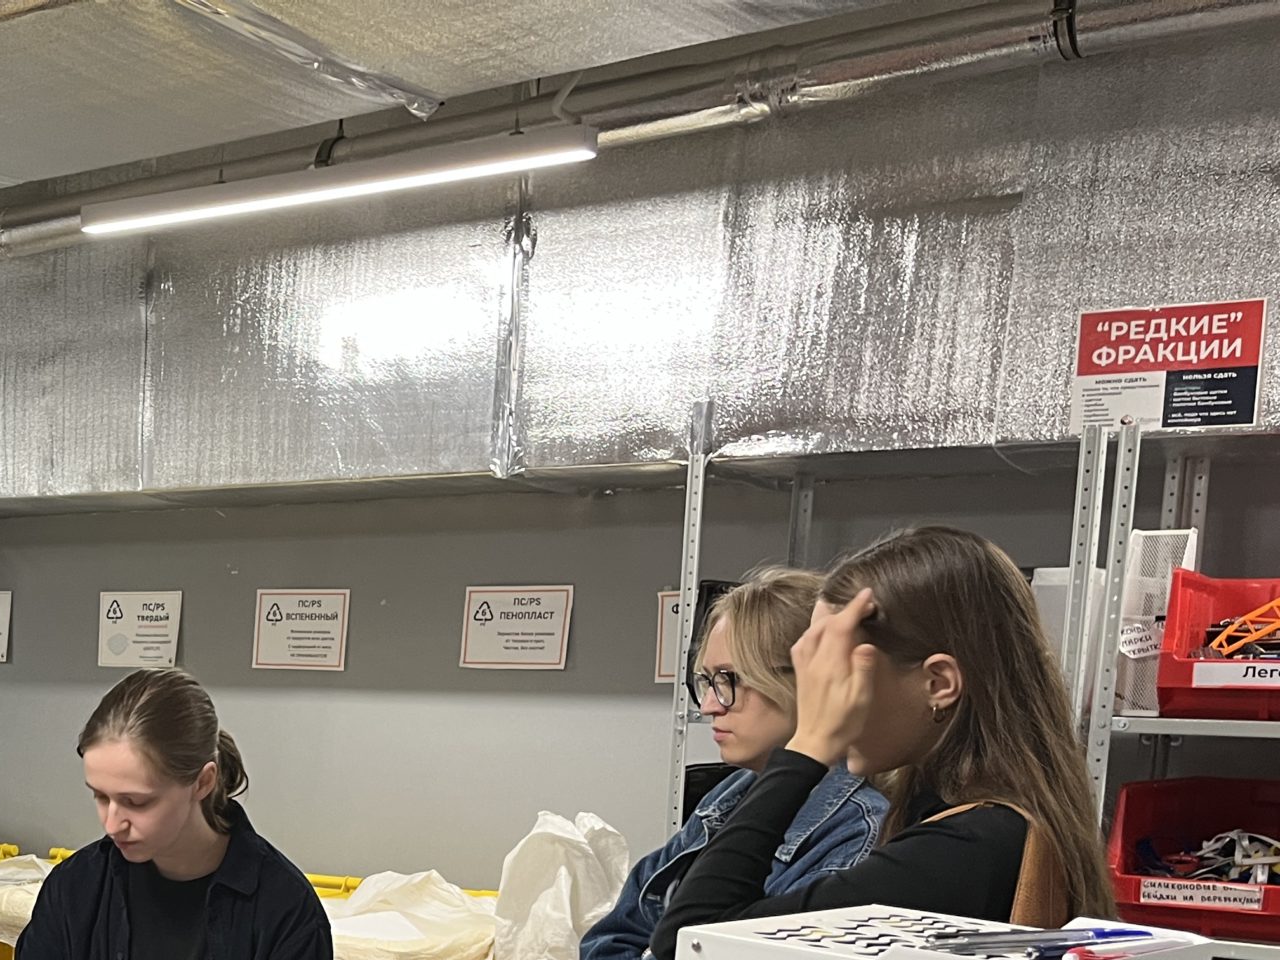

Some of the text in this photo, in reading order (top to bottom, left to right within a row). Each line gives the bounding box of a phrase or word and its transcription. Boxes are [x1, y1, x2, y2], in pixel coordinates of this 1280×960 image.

[1091, 337, 1243, 367] ФРАКЦИИ
[137, 612, 170, 623] твердый
[285, 610, 339, 621] ВСПЕНЕННЫЙ
[499, 611, 555, 620] ПЕНОПЛАСТ
[1242, 665, 1280, 679] Лег
